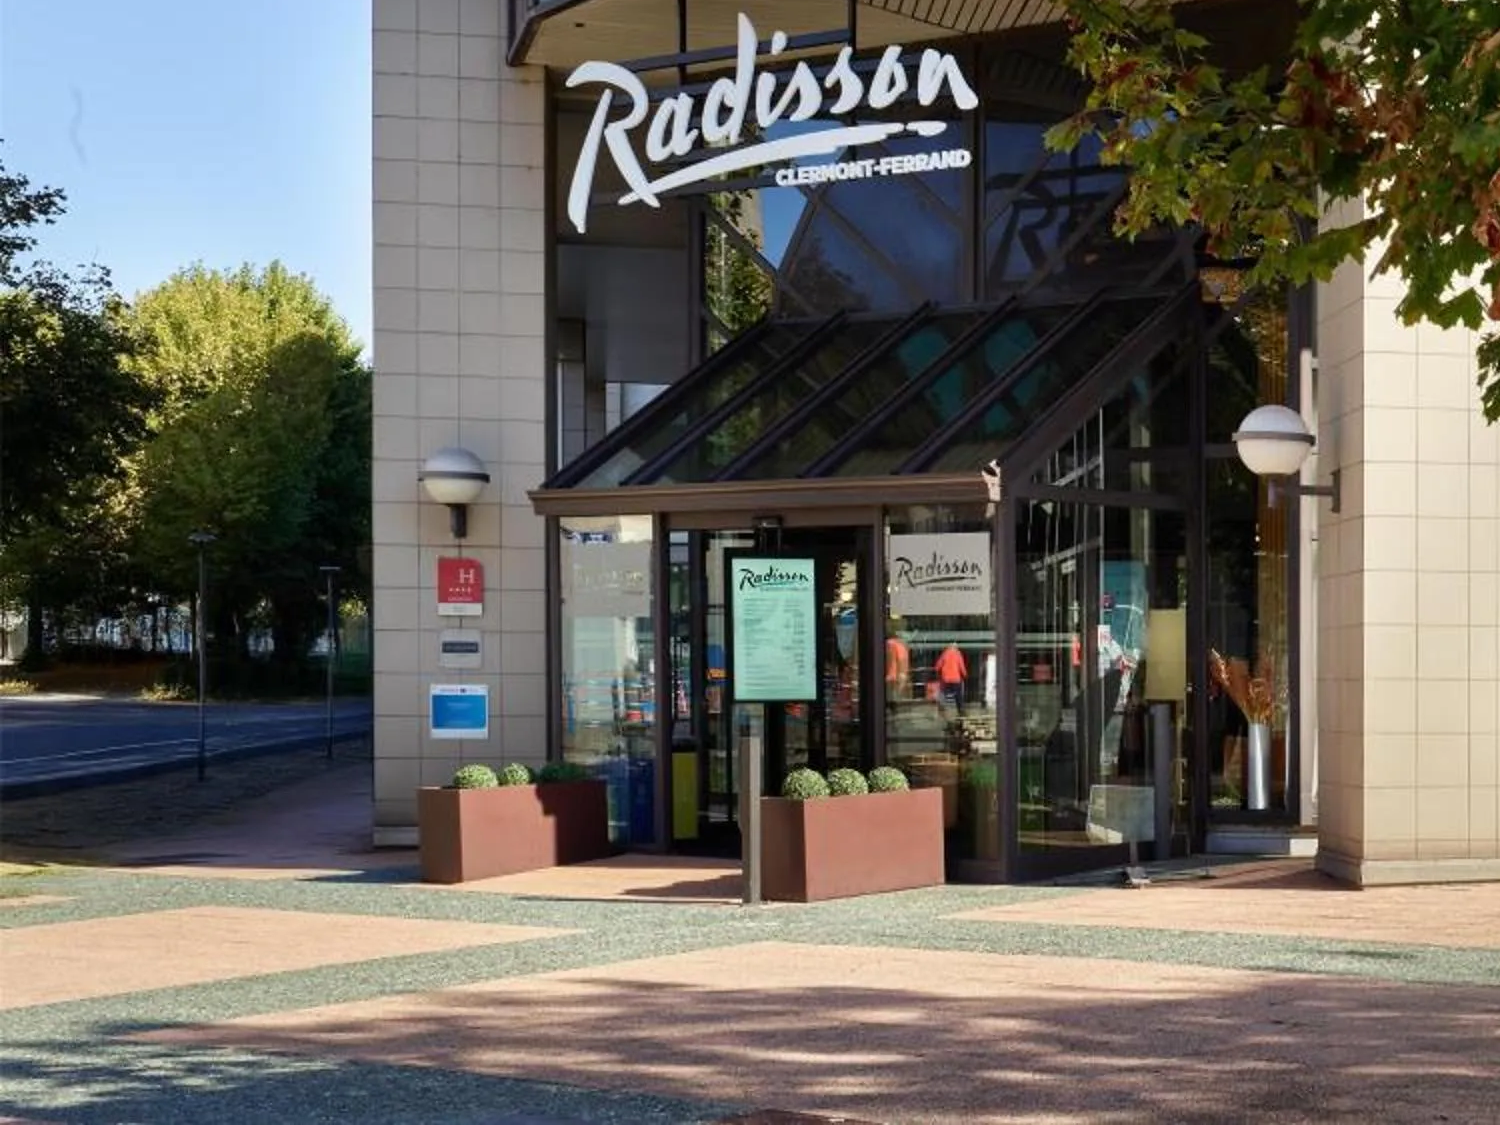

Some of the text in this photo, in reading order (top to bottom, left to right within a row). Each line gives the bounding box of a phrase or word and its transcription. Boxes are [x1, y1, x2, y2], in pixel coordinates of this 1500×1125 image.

[566, 12, 979, 233] Radisson
[775, 148, 972, 187] CLERMONT-FERRAND
[458, 568, 475, 584] H
[738, 565, 809, 591] Radisson
[894, 551, 983, 588] Radisson
